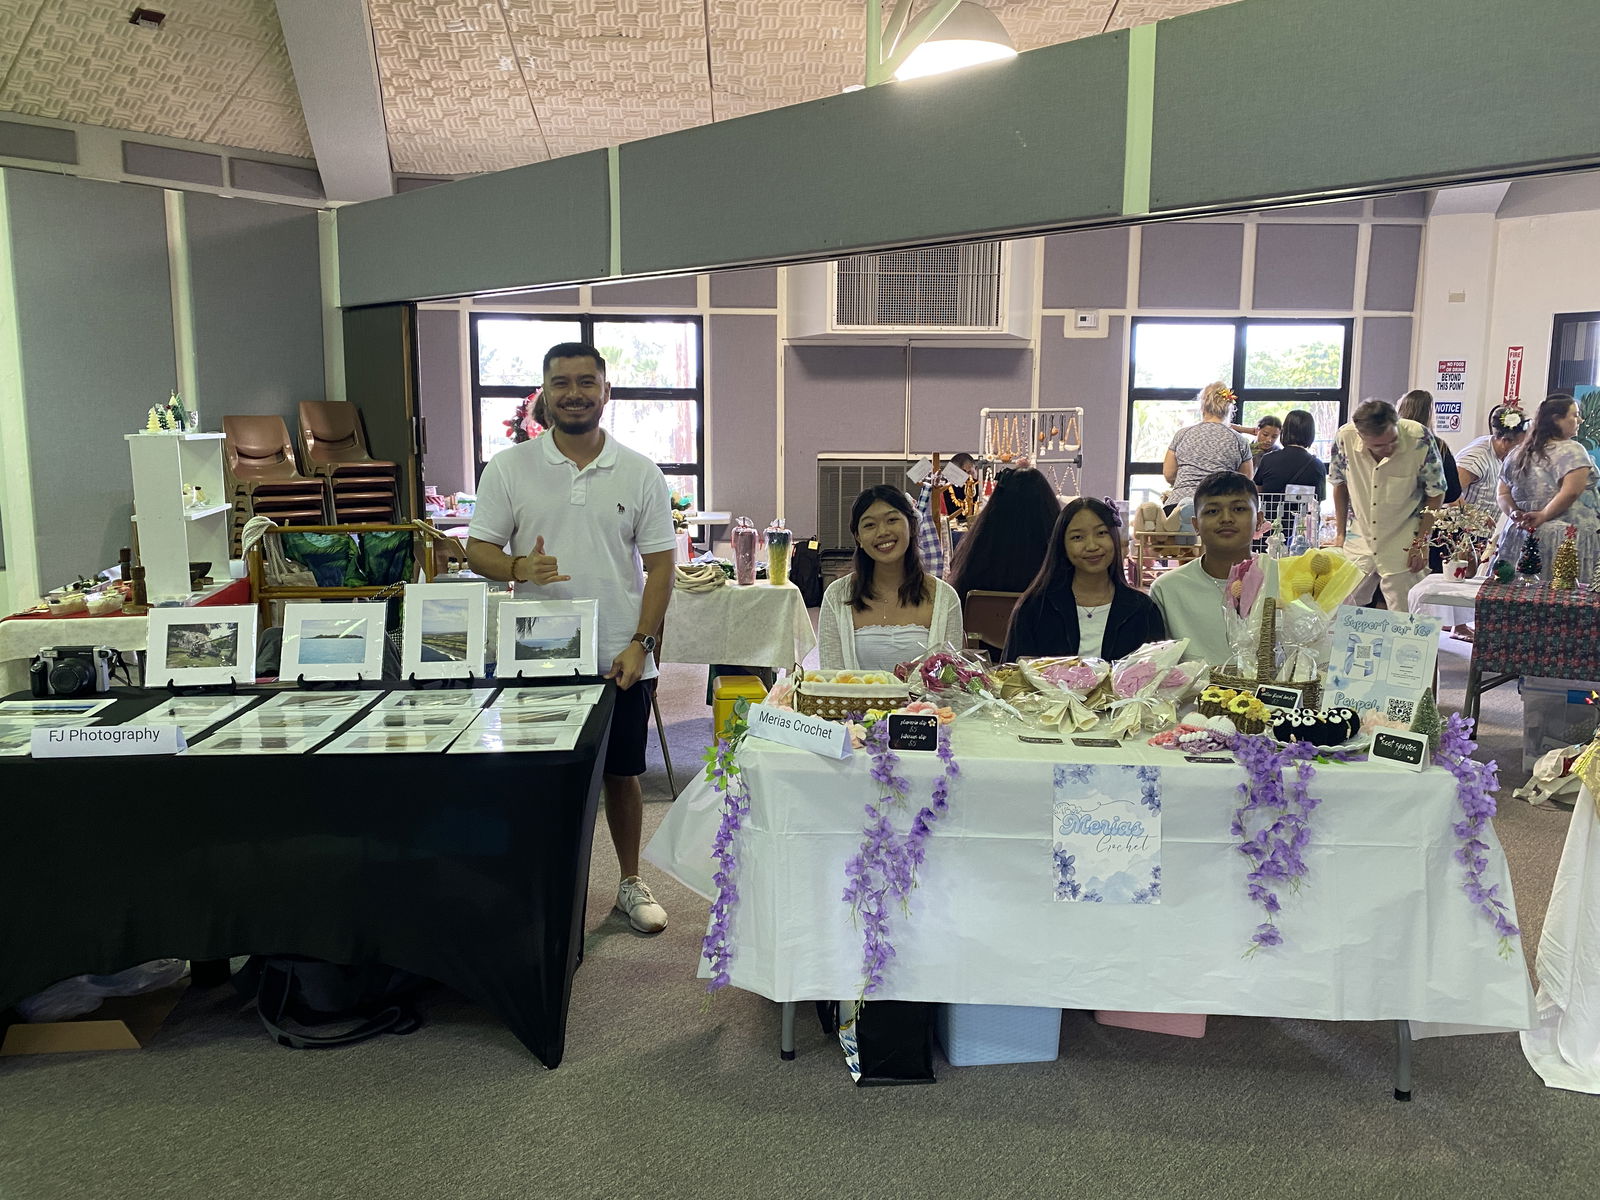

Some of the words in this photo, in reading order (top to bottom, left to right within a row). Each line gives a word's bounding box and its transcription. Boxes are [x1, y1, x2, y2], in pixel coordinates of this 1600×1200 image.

[1441, 373, 1461, 381] BEYOND
[1437, 382, 1449, 390] THIS
[1448, 382, 1464, 390] POINT
[1435, 403, 1461, 413] NOTICE
[1343, 615, 1390, 633] Support
[1391, 624, 1412, 636] our
[759, 710, 792, 729] Merias
[793, 719, 833, 740] Crochet
[49, 730, 64, 742] FJ
[69, 728, 160, 744] Photography
[1059, 813, 1145, 836] Merias
[1096, 834, 1158, 853] Crochet
